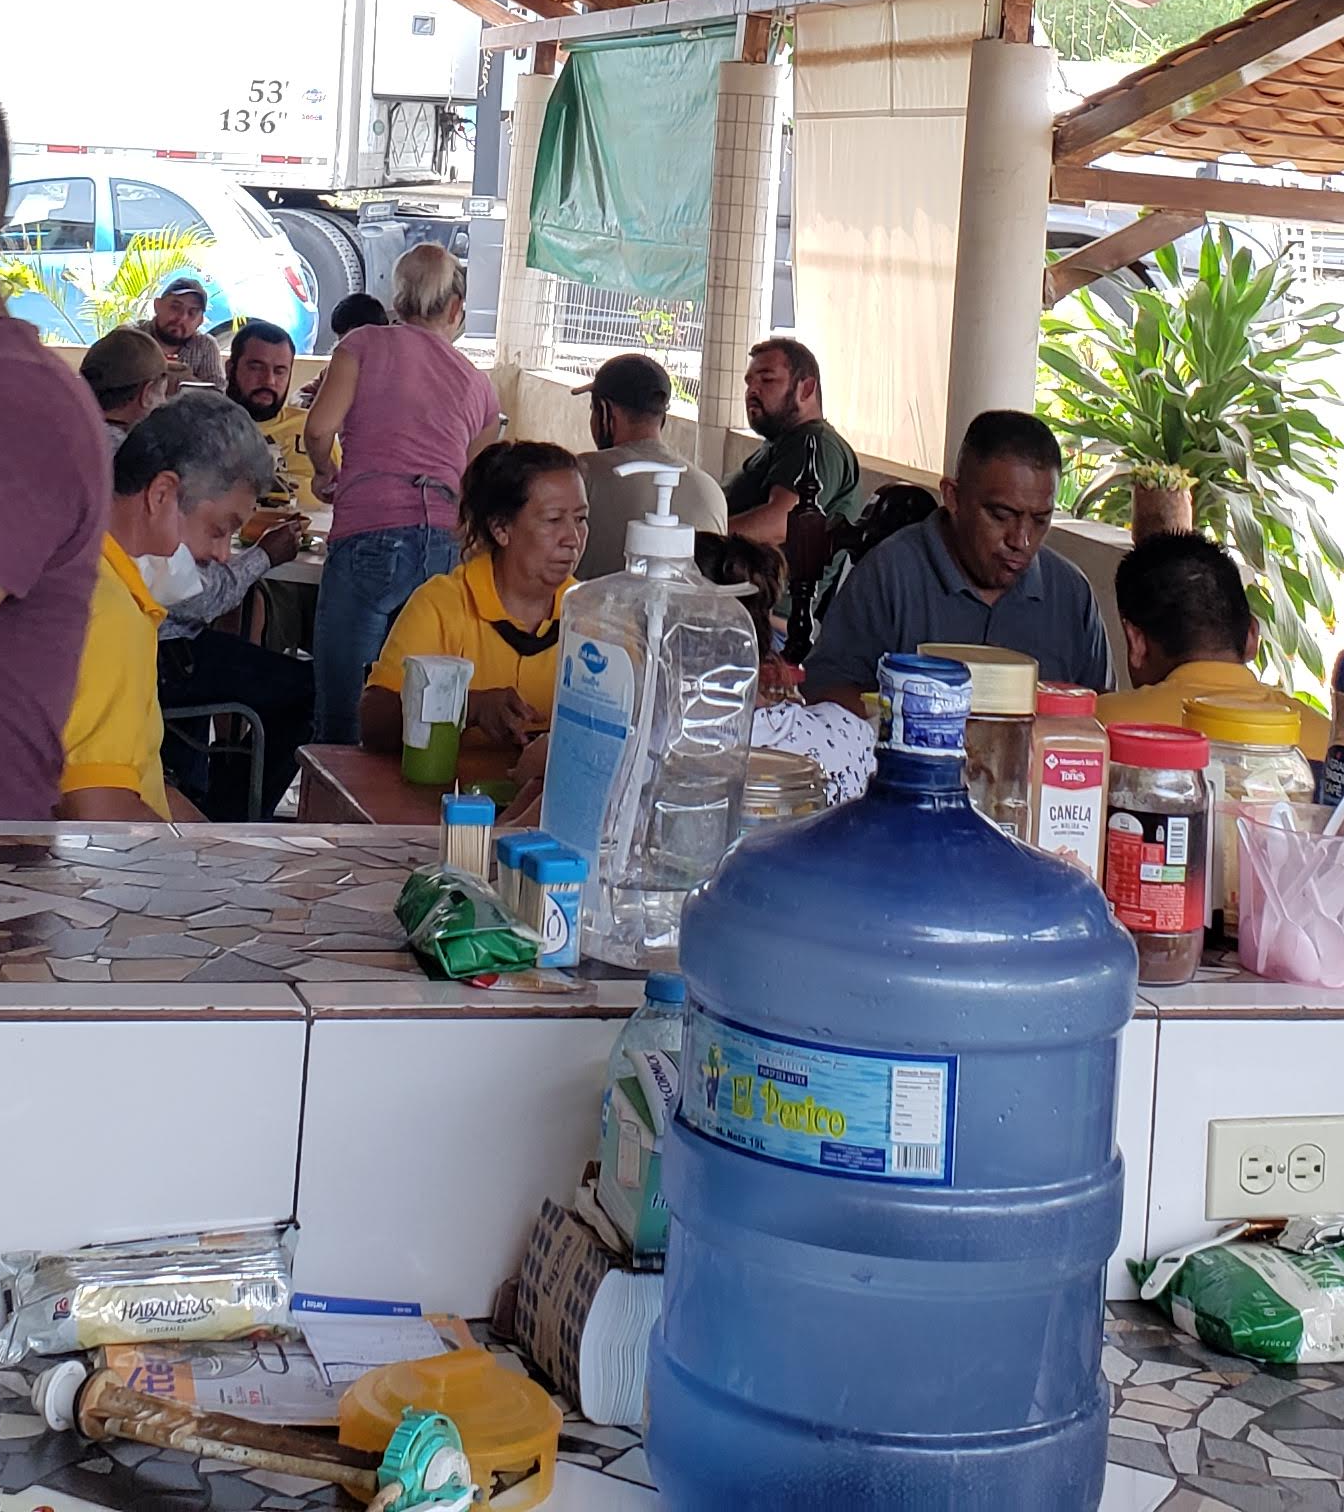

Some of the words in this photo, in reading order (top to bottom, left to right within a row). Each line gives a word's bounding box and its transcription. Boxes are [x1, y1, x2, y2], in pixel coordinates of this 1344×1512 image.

[249, 80, 289, 103] 53'
[1049, 805, 1091, 822] CANELA
[759, 1066, 786, 1082] PURIFIED
[787, 1074, 807, 1087] WATER
[732, 1076, 754, 1119] El
[760, 1079, 847, 1139] Perico
[120, 1297, 216, 1320] HABANERAS
[146, 1325, 185, 1334] INTEGRALES
